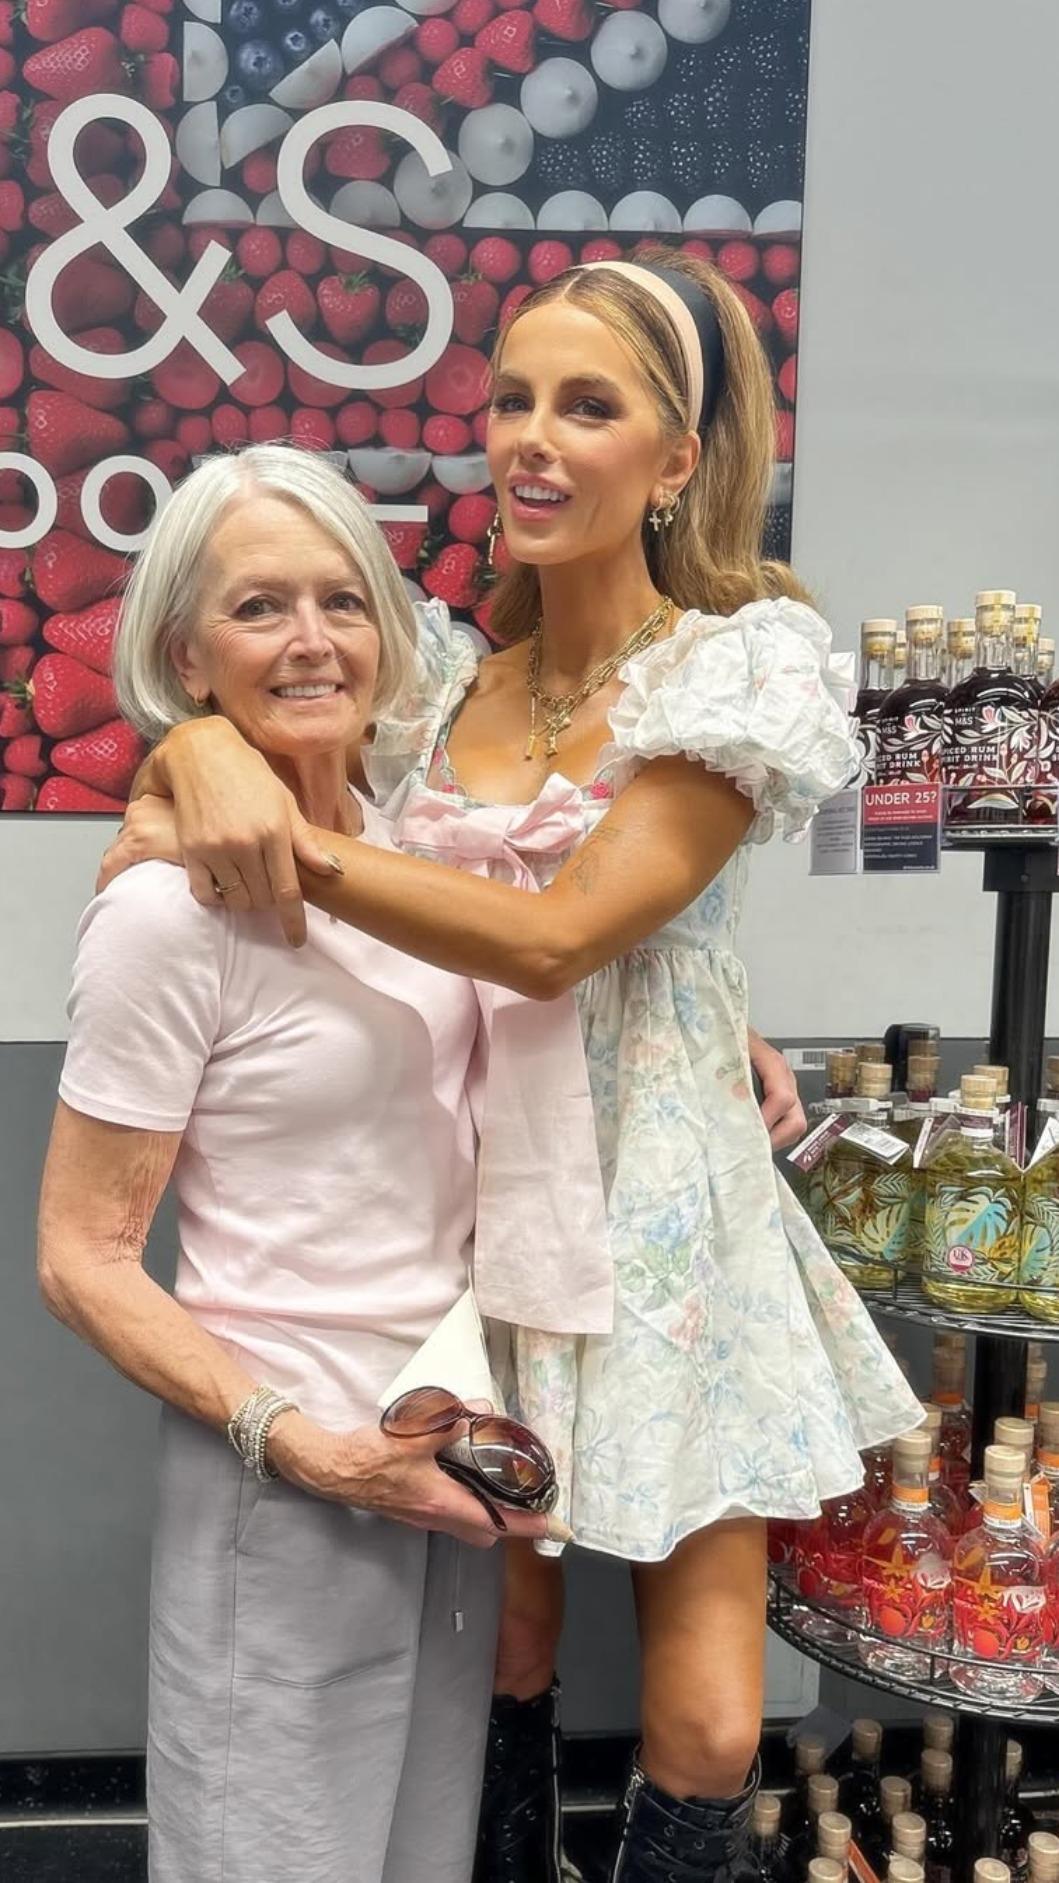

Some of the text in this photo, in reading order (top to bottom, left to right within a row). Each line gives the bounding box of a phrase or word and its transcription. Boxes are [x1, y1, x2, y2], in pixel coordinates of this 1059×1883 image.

[963, 754, 999, 762] DRINK
[888, 760, 921, 768] DRINK
[865, 791, 937, 806] UNDER 25?
